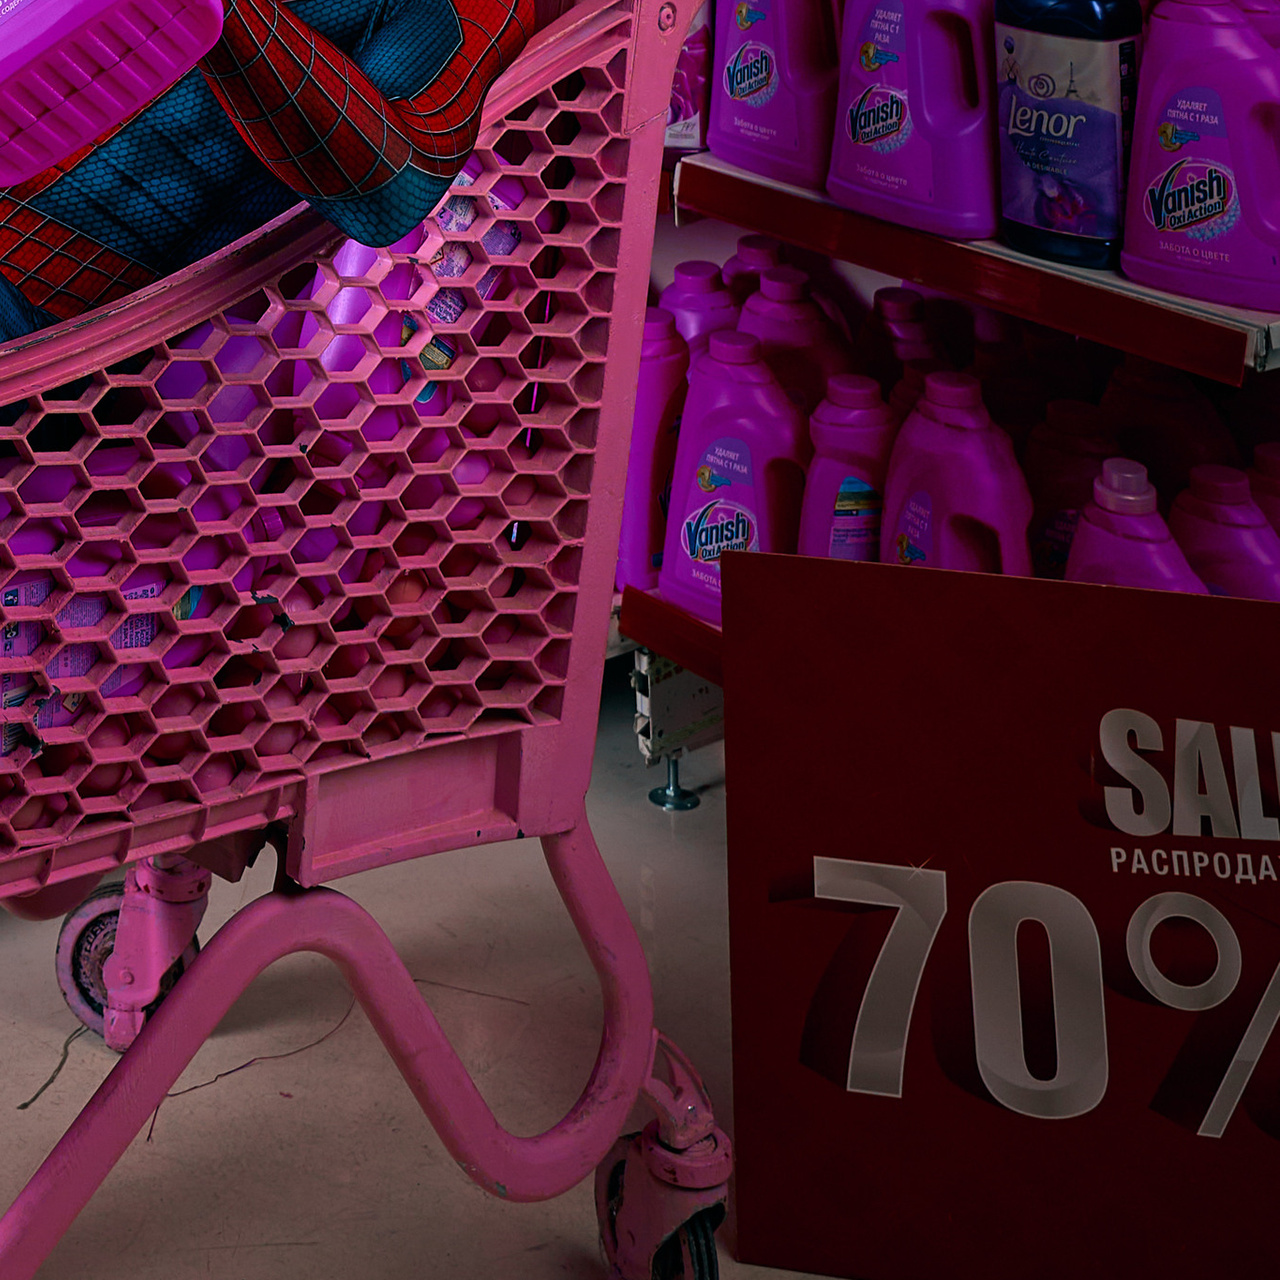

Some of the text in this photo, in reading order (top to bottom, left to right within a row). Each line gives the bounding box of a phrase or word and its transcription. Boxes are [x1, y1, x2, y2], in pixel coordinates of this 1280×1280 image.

[726, 41, 770, 99] Vanish
[849, 84, 902, 144] Vanish
[1008, 95, 1086, 138] Lenor
[1177, 99, 1207, 112] УДАЛЯЕТ
[861, 121, 899, 141] Oxi Action
[1148, 157, 1227, 230] Vanish
[1169, 200, 1222, 227] Oxi Action
[1159, 241, 1230, 263] ЗАБОТА О ЦВЕТЕ
[685, 499, 750, 560] Vanish
[1099, 708, 1280, 841] SAL
